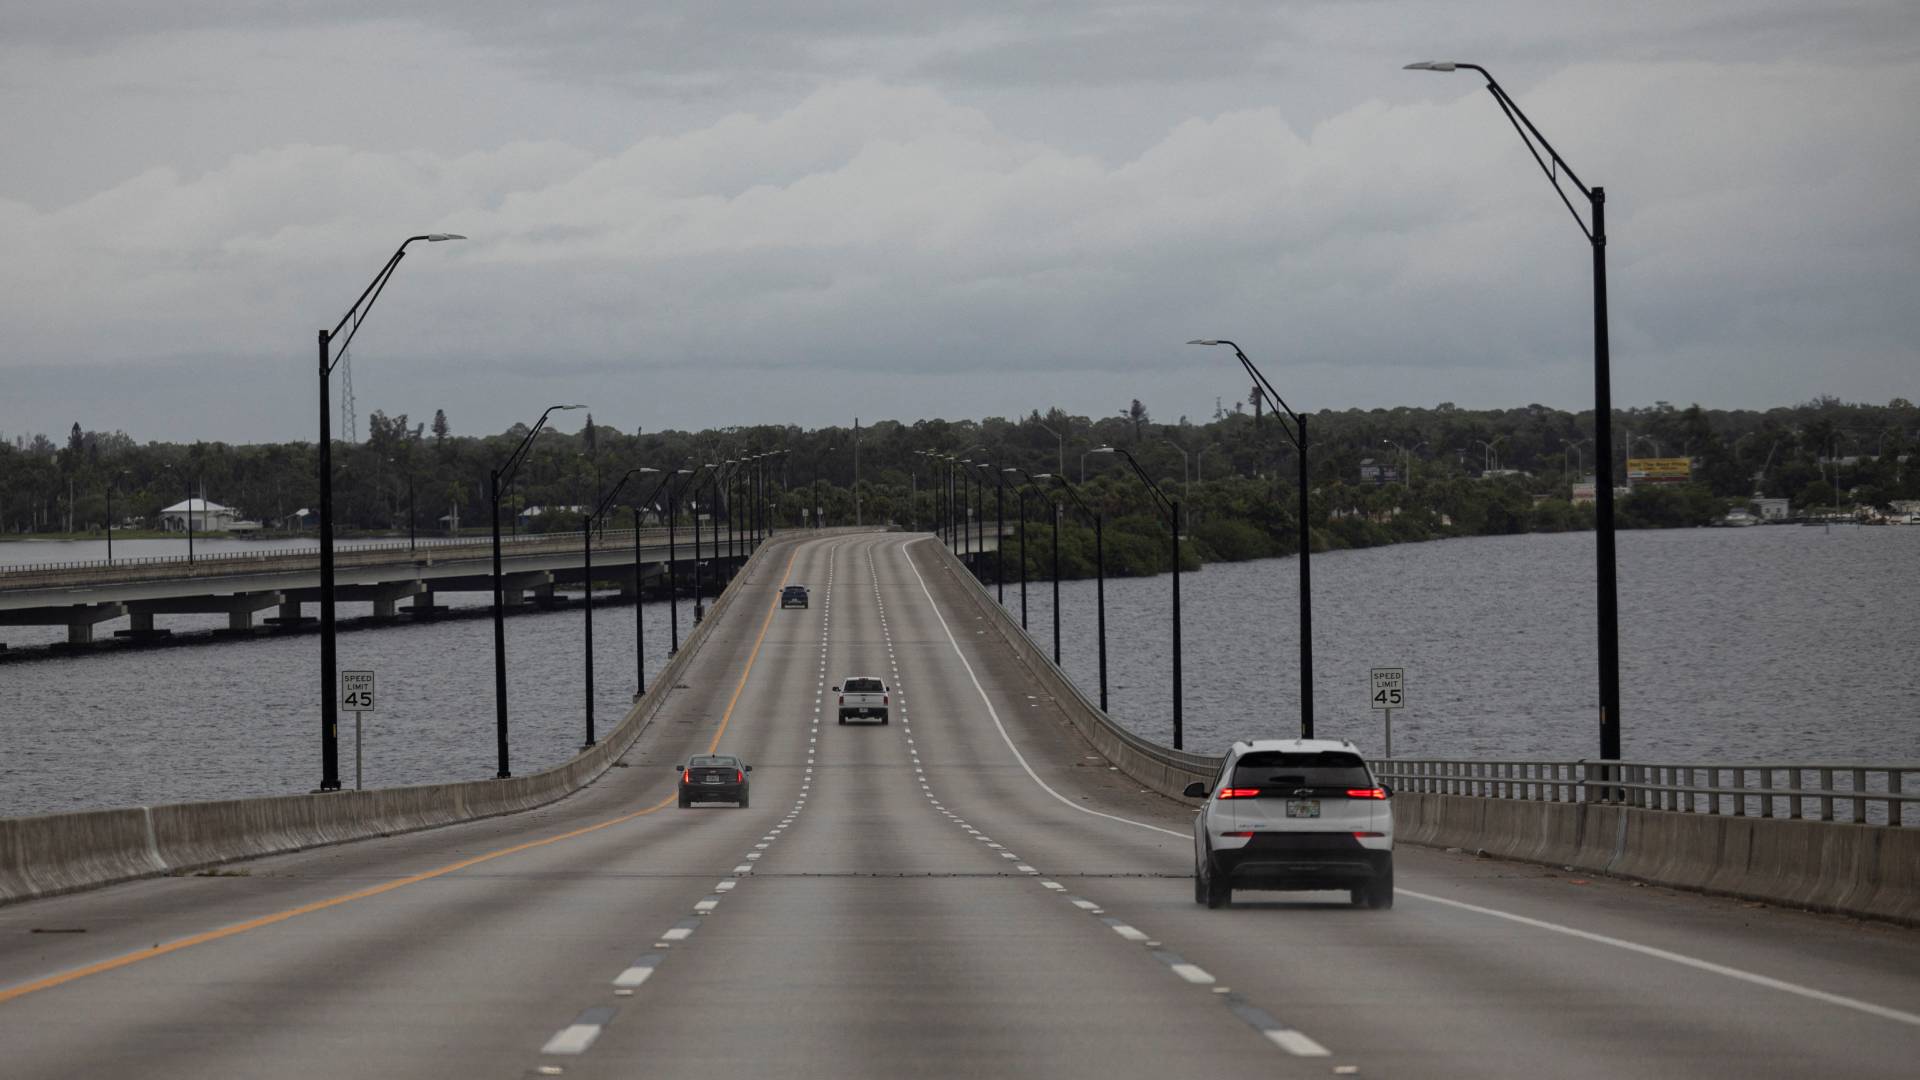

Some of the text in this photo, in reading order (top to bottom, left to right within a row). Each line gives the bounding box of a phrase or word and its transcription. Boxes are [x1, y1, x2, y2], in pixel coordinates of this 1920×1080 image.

[1374, 672, 1401, 680] SPEED
[345, 692, 372, 707] 45
[1374, 689, 1401, 704] 45
